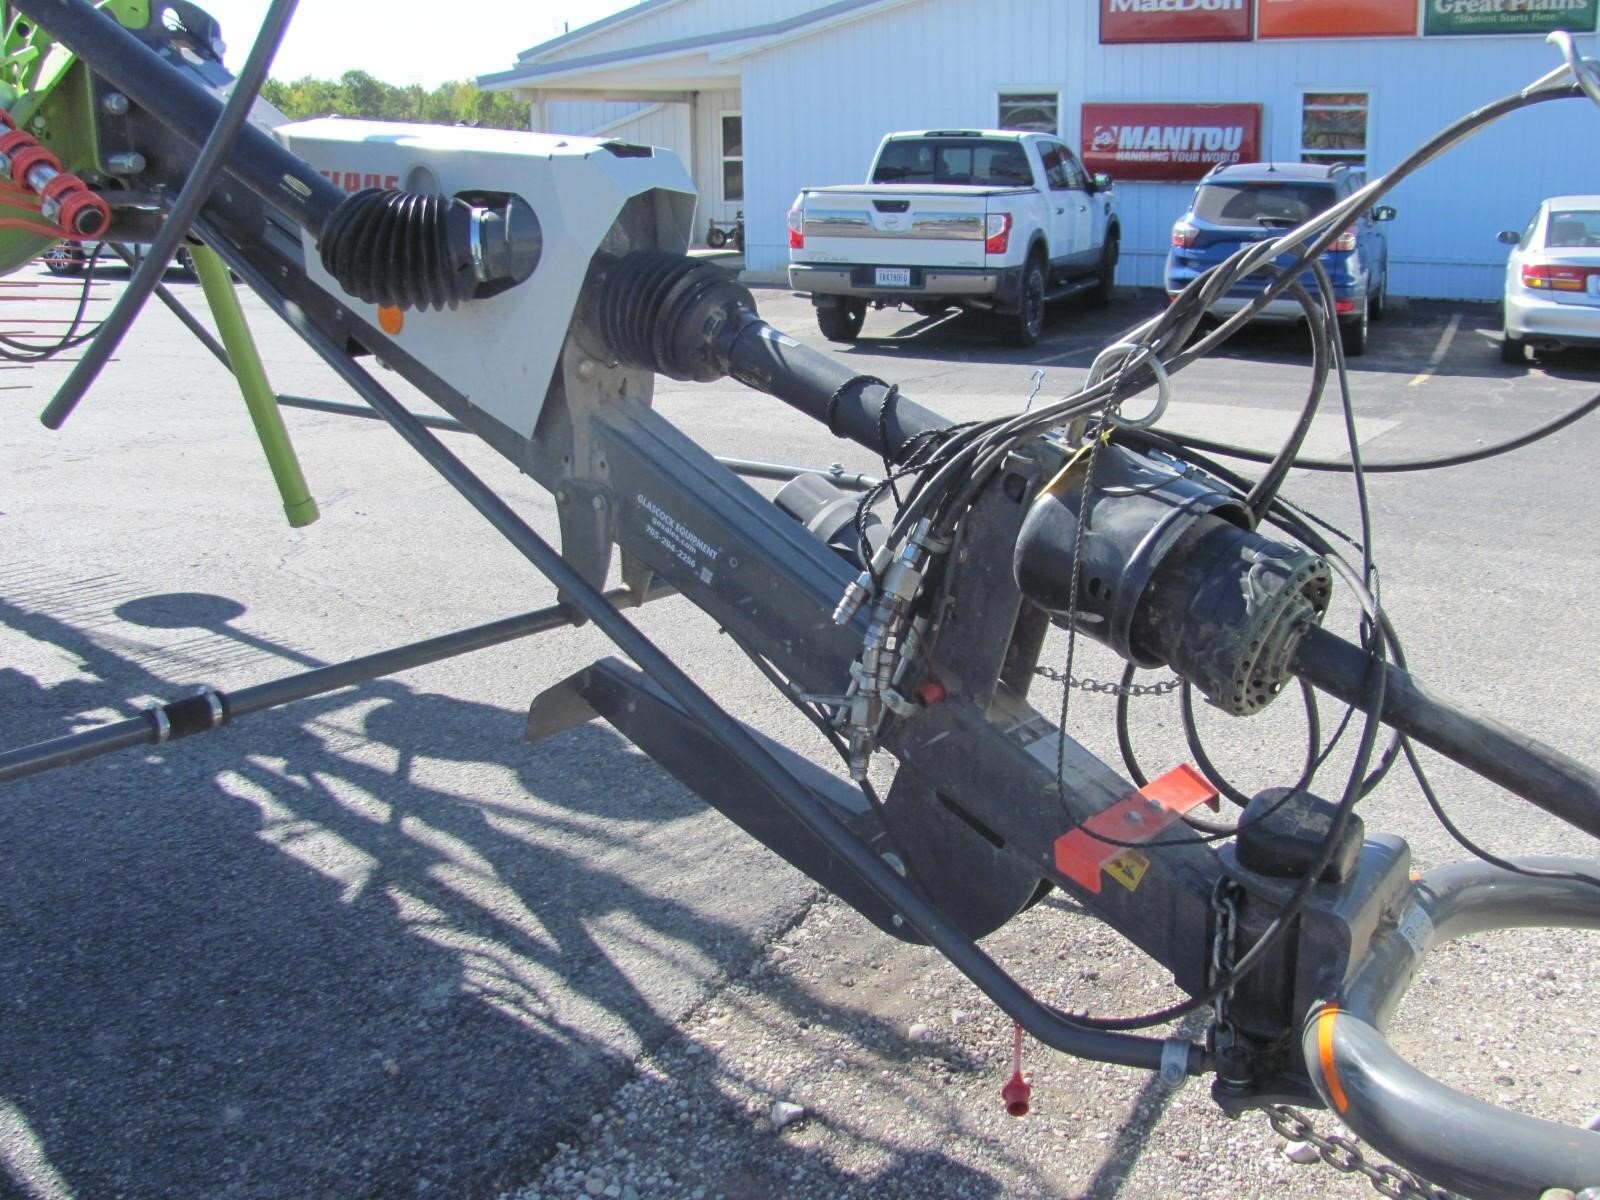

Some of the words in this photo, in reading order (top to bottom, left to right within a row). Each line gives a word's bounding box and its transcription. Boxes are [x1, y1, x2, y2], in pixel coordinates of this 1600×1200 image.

[1109, 0, 1243, 12] MacDon
[1434, 0, 1502, 13] Great
[1508, 0, 1588, 11] Plains
[1499, 12, 1529, 23] Starts
[1117, 126, 1244, 151] MANITOU
[1116, 151, 1170, 162] HANDLING
[1171, 152, 1200, 163] YOUR
[1201, 152, 1240, 163] WORLD
[637, 493, 676, 529] GLASCOCK
[674, 521, 718, 560] EQUIPMENT
